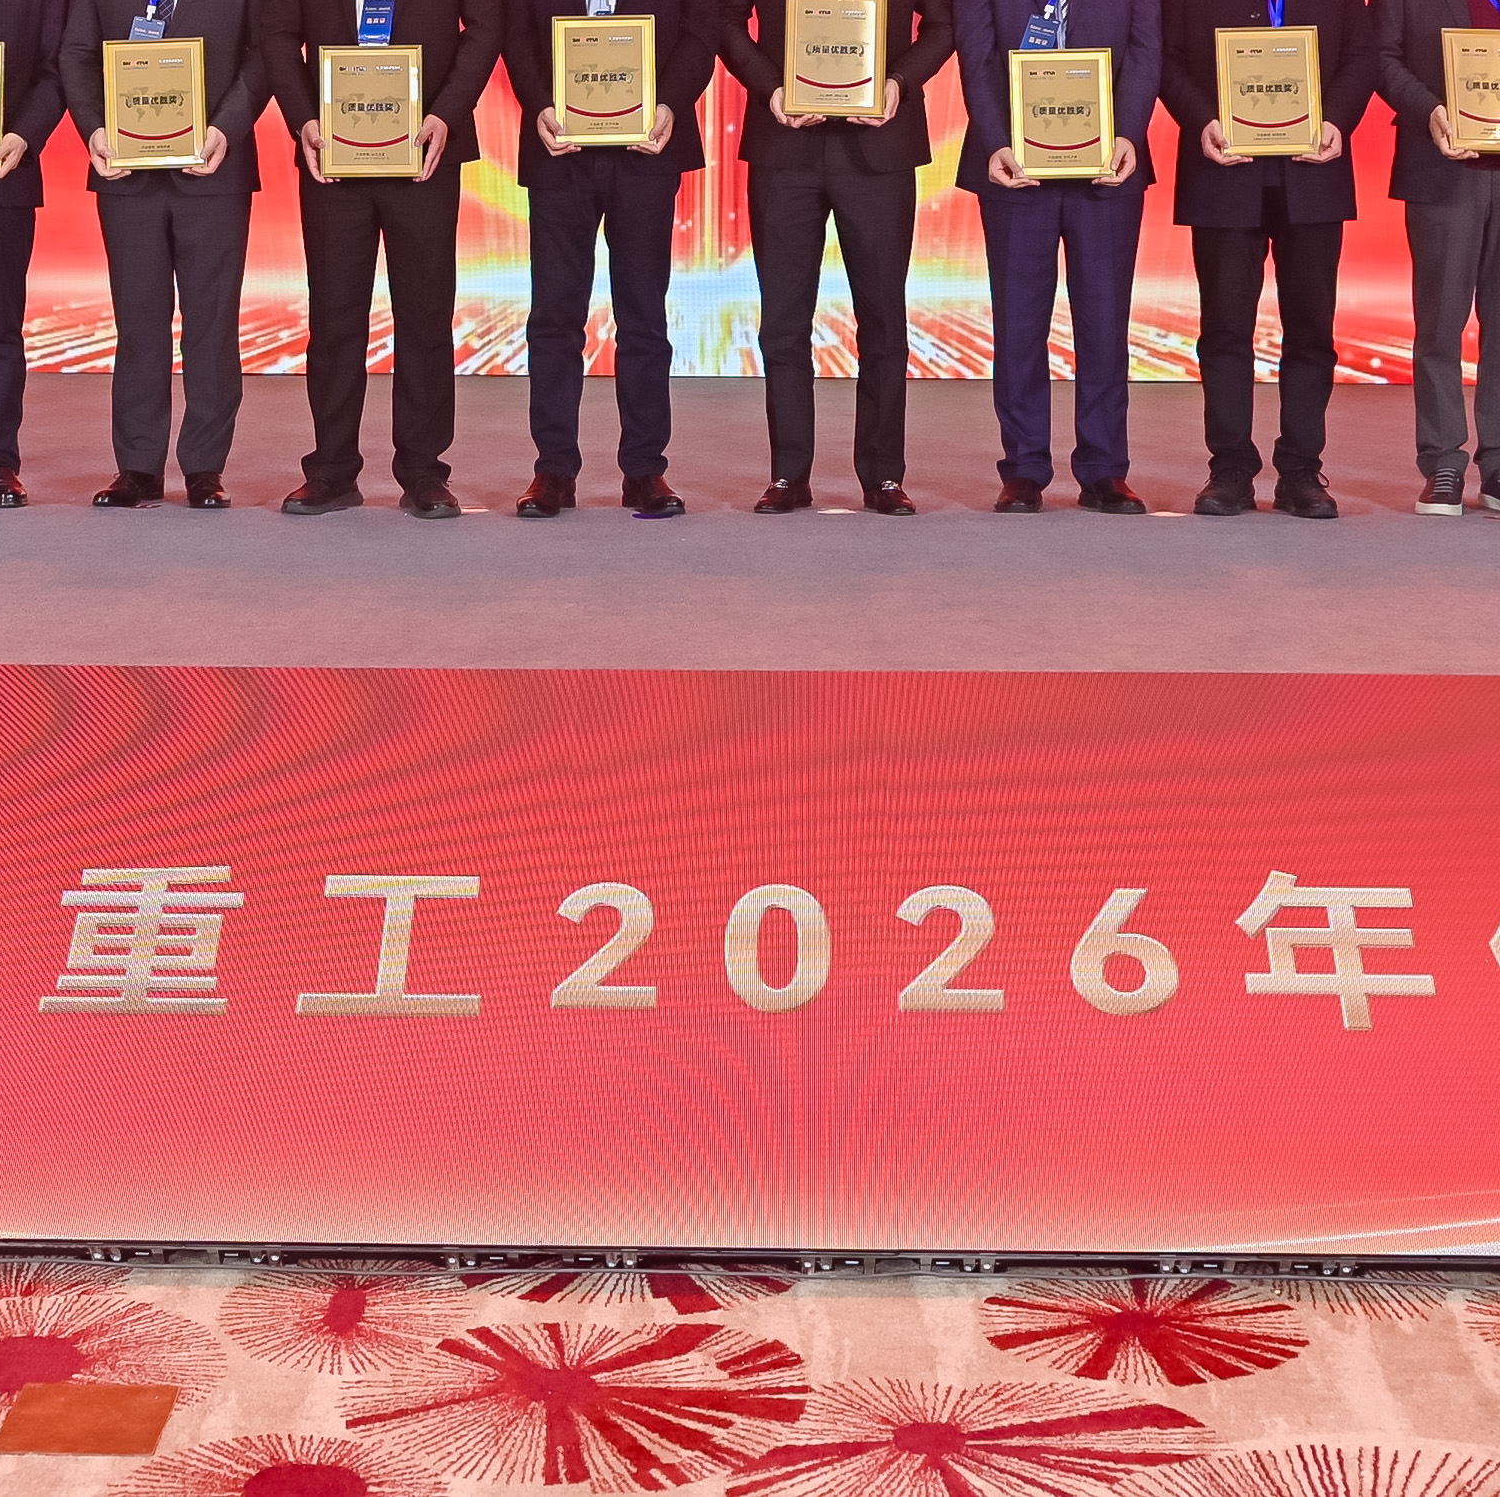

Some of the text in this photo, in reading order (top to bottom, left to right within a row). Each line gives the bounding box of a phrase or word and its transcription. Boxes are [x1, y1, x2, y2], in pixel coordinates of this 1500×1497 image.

[812, 45, 858, 54] 质量优胜奖
[1247, 84, 1293, 93] 质量优胜奖
